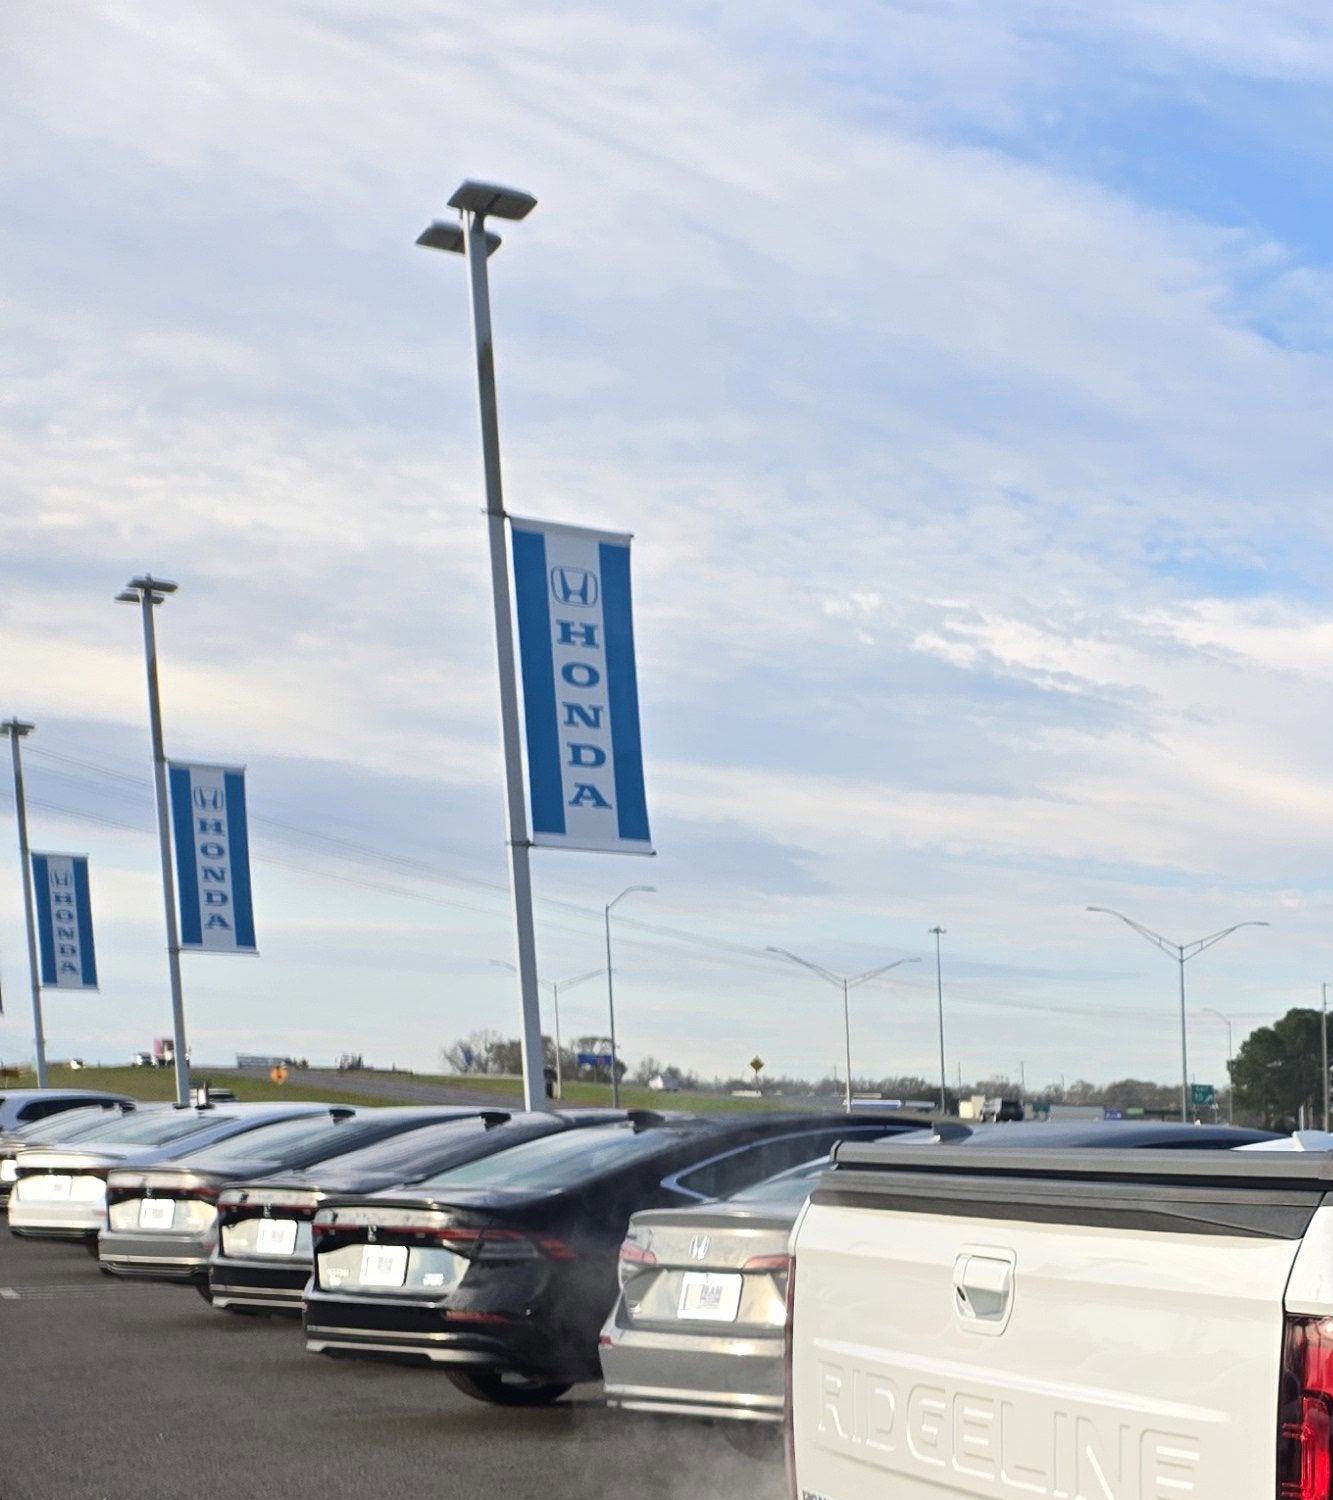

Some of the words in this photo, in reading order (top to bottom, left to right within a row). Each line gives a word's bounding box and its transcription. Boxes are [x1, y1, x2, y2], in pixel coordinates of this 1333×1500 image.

[556, 619, 612, 810] HONDA
[197, 817, 232, 930] HONDA
[53, 891, 79, 974] HONDA
